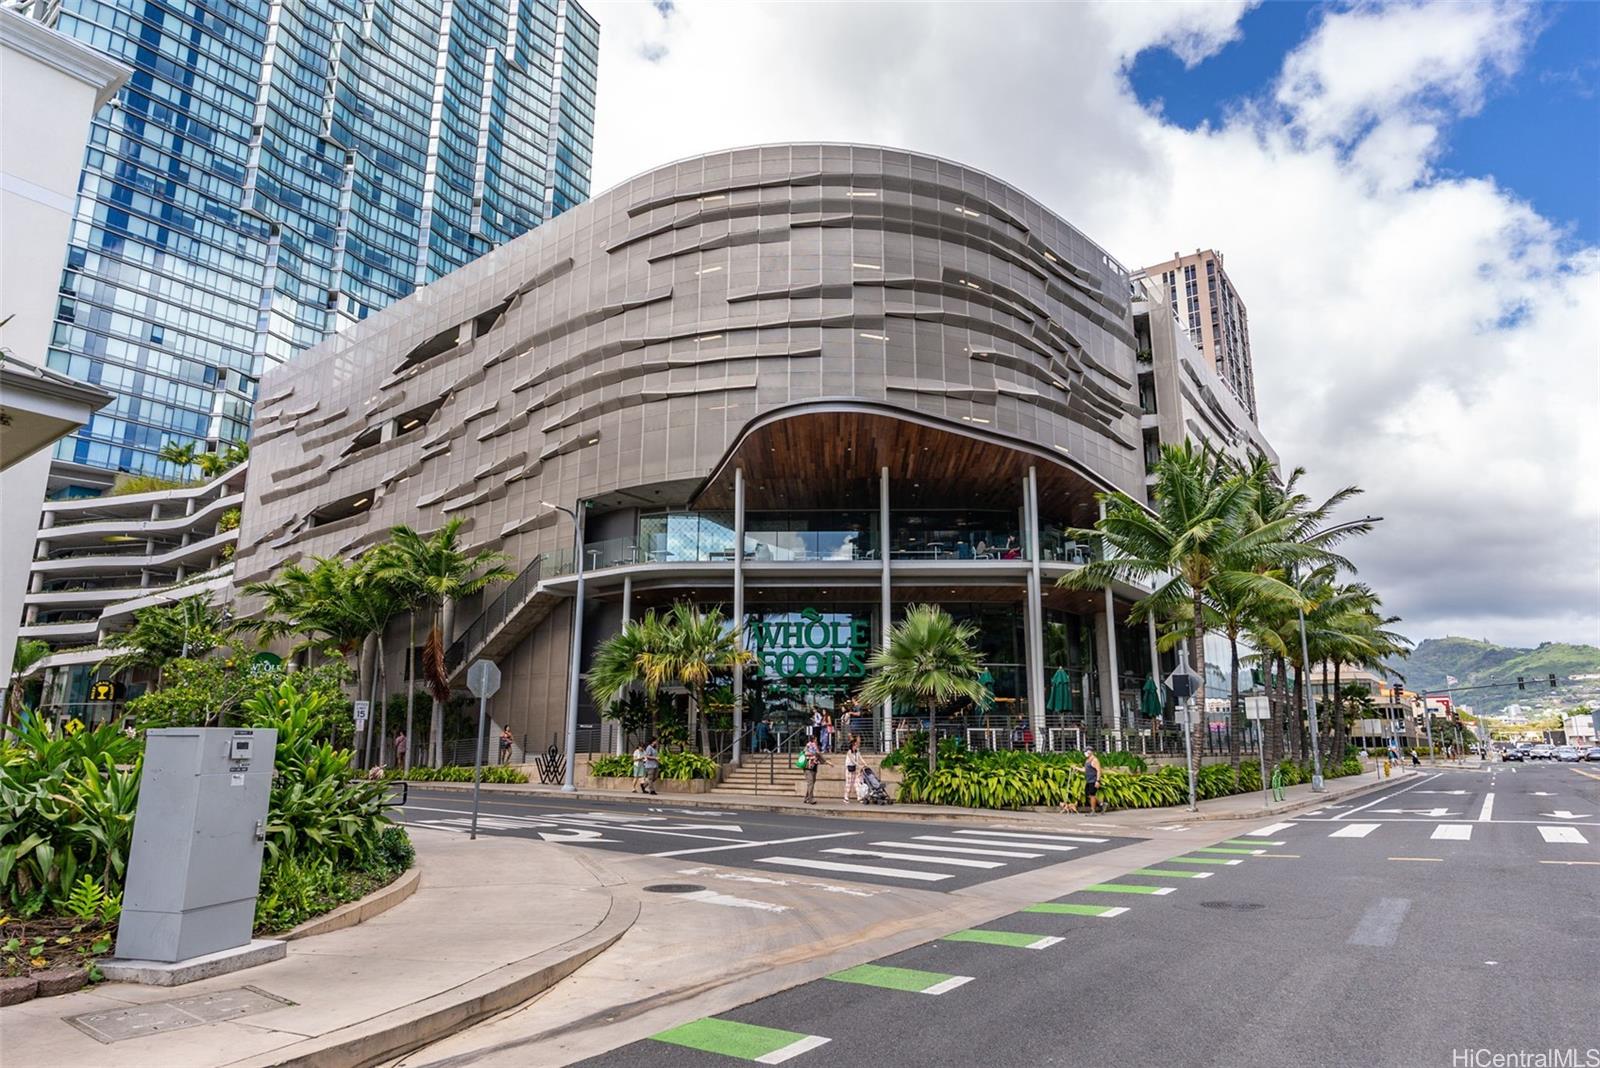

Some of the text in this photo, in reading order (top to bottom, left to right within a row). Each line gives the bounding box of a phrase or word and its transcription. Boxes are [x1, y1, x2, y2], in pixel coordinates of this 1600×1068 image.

[750, 620, 869, 649] WHOLE
[756, 650, 866, 679] FOODS
[768, 684, 849, 695] MARKET
[356, 710, 366, 718] 15
